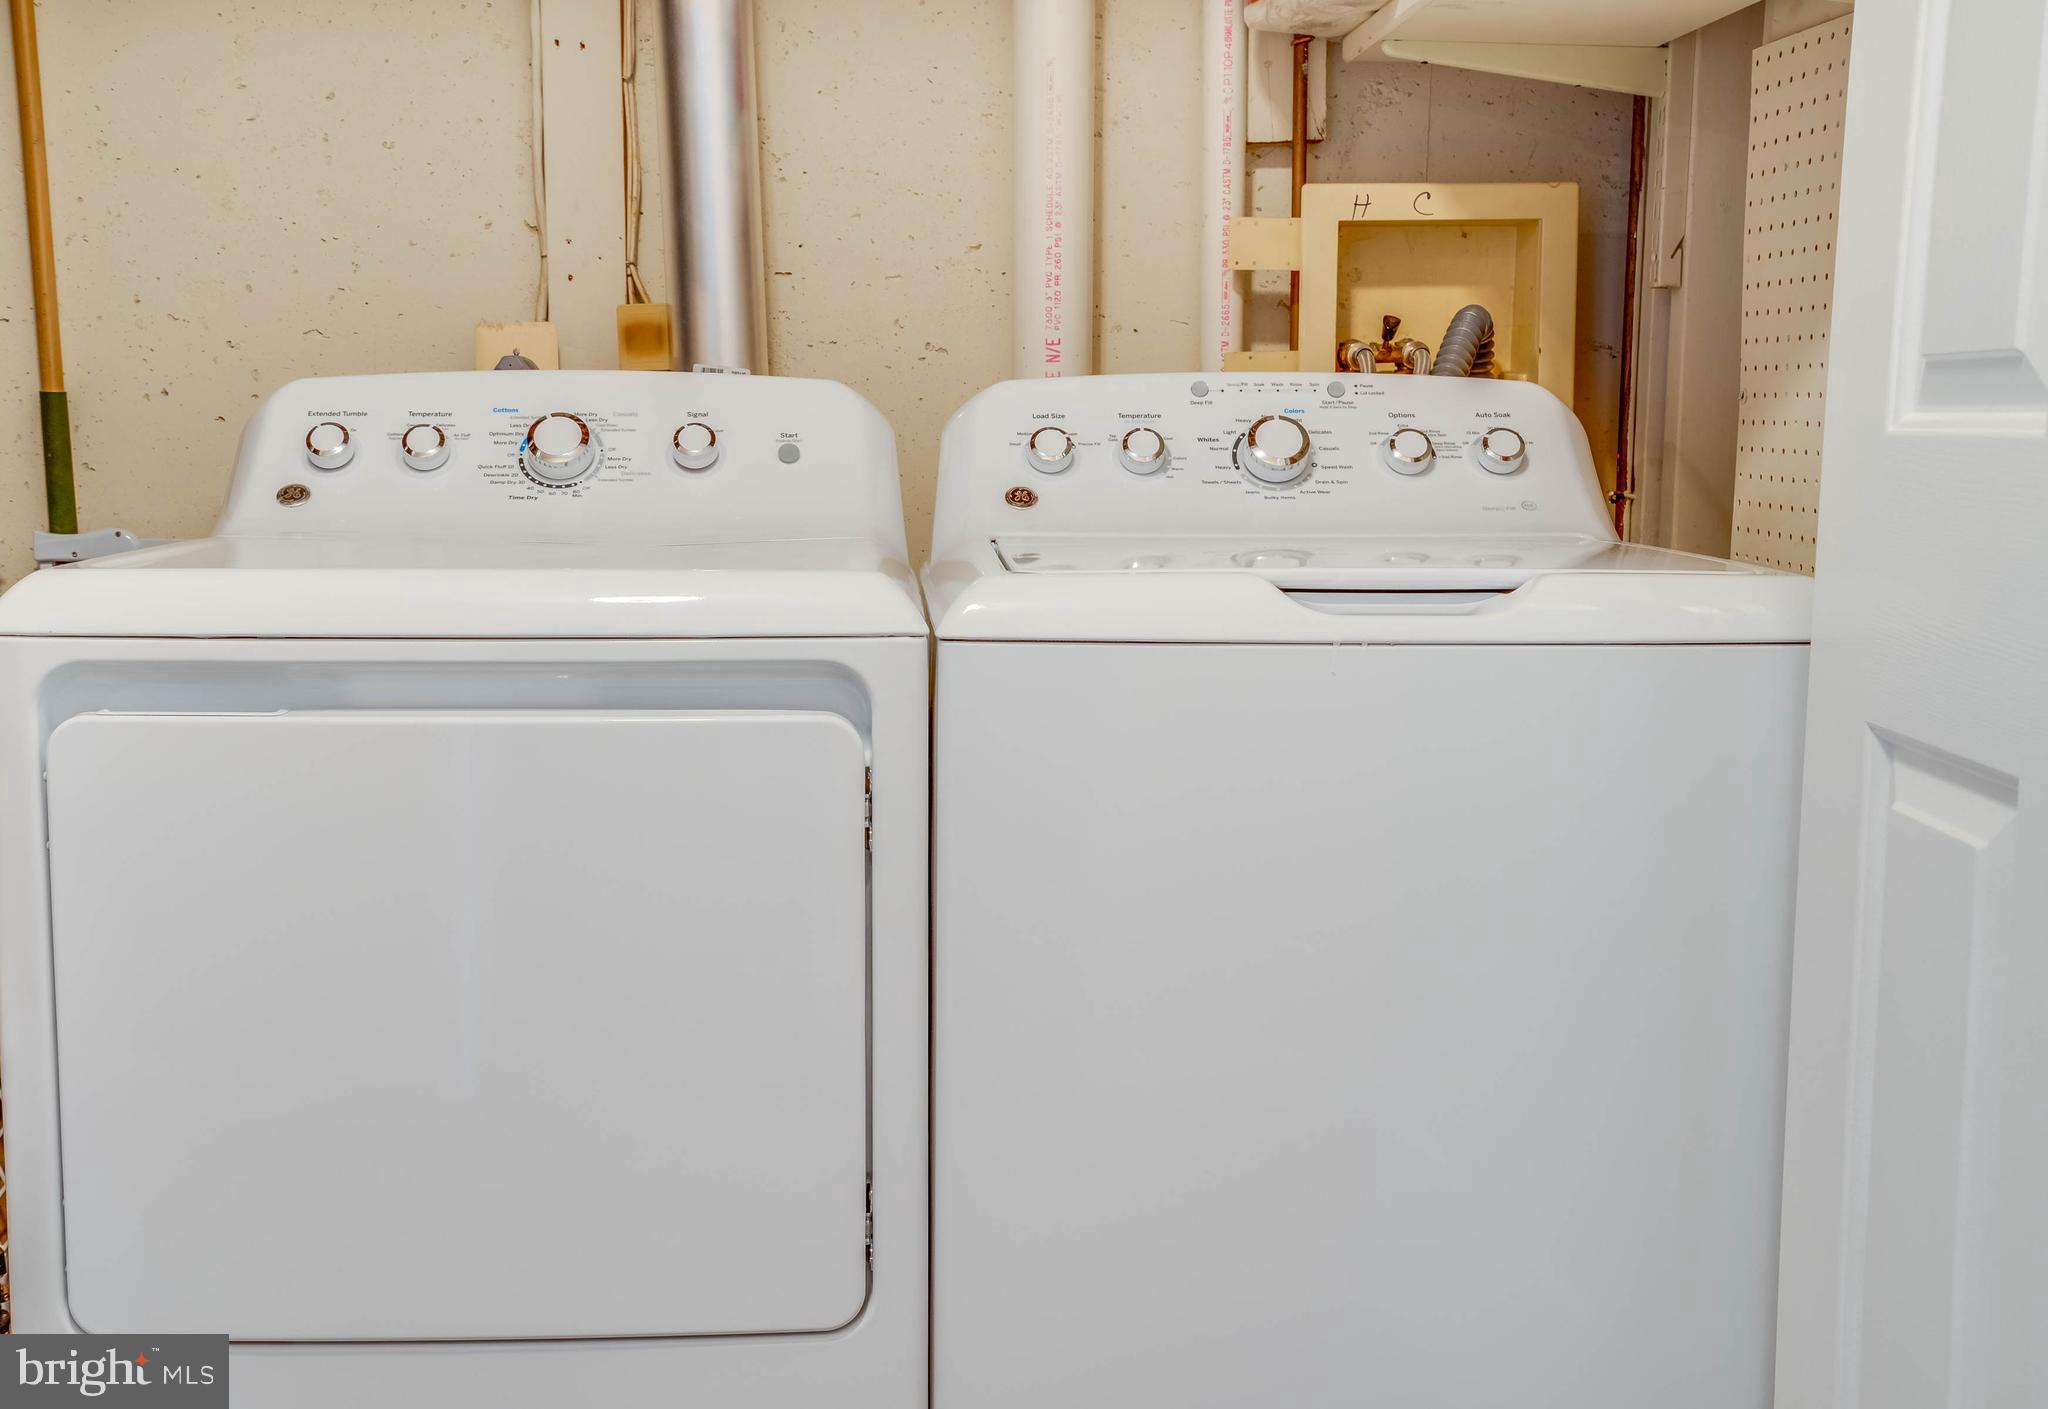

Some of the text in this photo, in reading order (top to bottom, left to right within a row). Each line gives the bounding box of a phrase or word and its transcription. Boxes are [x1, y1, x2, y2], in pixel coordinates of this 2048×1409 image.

[1046, 184, 1054, 231] SCHEDULE
[1352, 191, 1434, 220] H C
[1045, 271, 1053, 288] PVC
[1045, 338, 1061, 363] N/E
[408, 410, 453, 418] Temperature
[1118, 412, 1162, 420] Temperature
